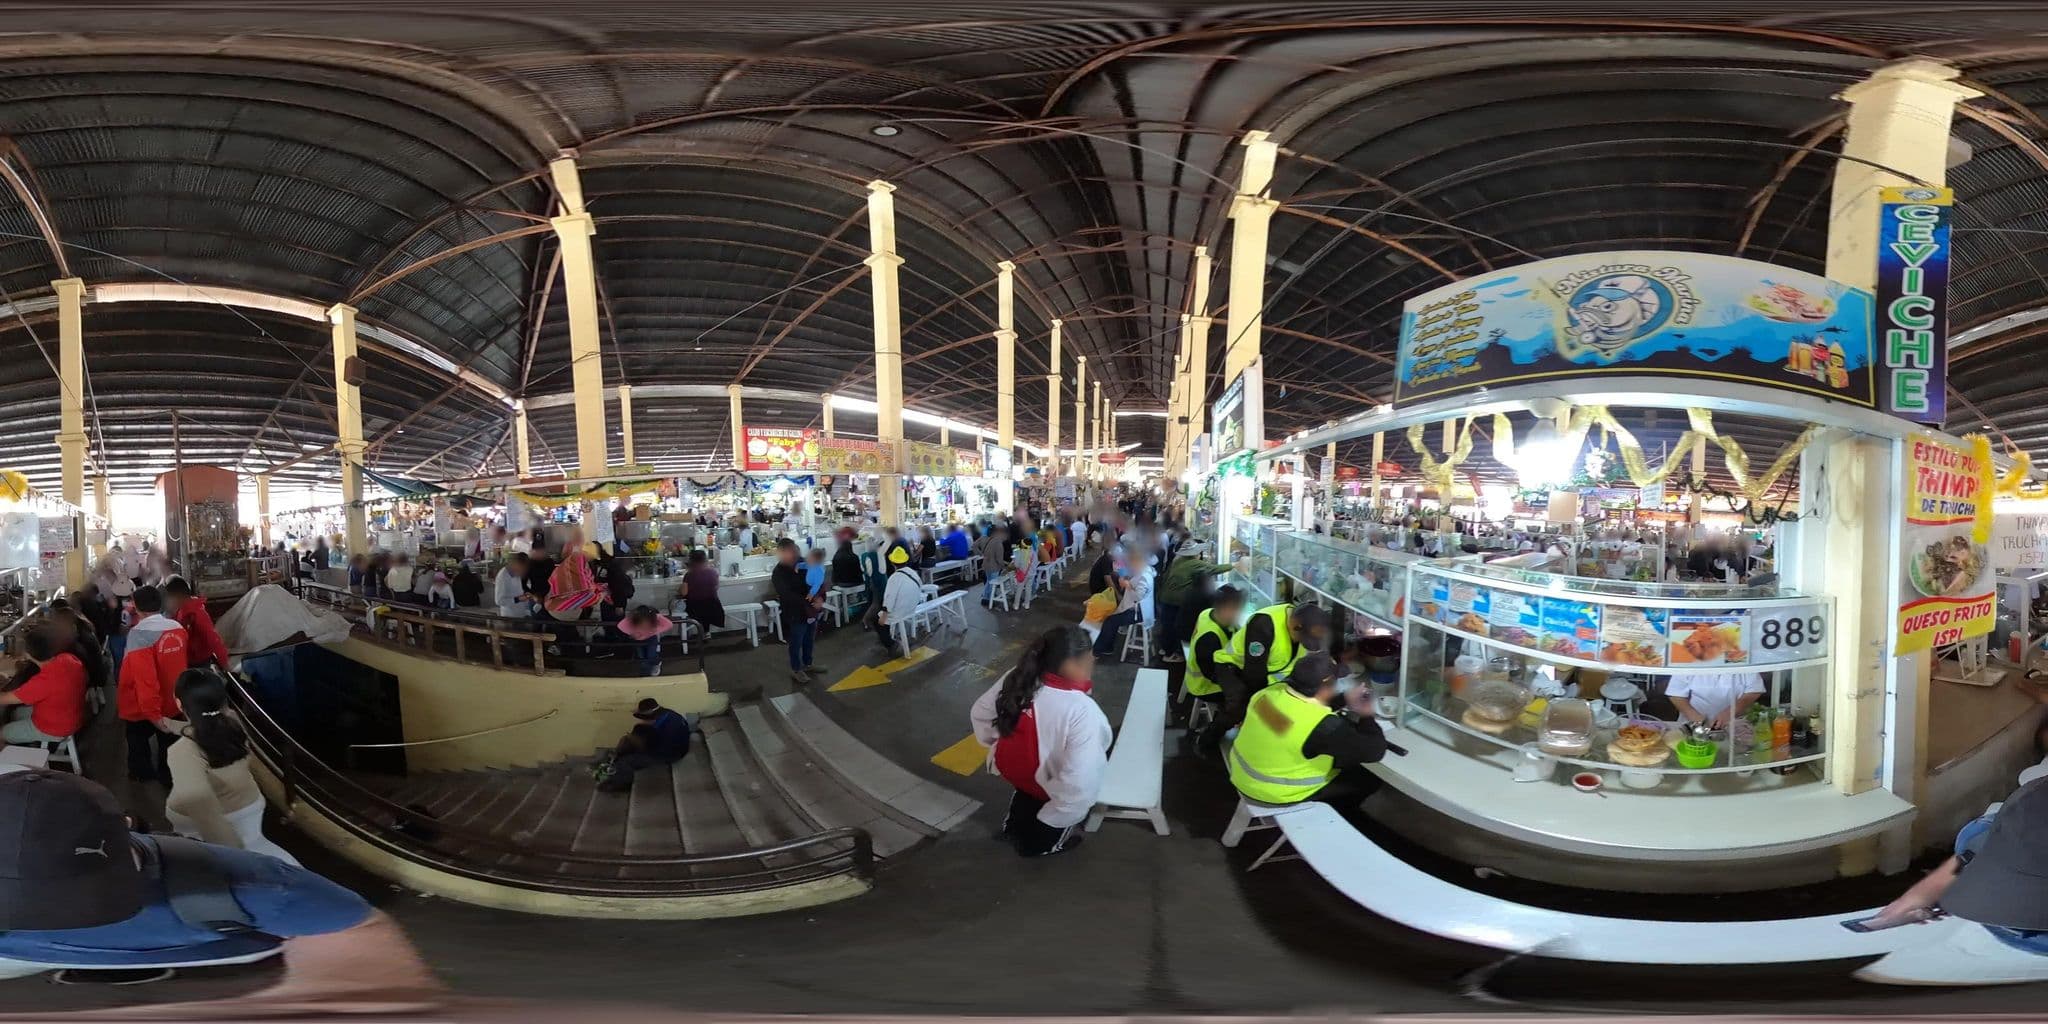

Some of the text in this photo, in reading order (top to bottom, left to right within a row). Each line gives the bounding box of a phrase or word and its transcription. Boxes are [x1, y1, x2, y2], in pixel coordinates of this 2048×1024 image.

[1652, 266, 1701, 325] Marina
[1886, 205, 1939, 413] CEVICHE
[1914, 441, 1957, 468] ESTILO
[1918, 467, 1979, 498] THIMP
[1922, 498, 1975, 515] DE TRUCHA
[1761, 615, 1825, 650] 889
[1903, 602, 1991, 634] QUESO FRITO
[1933, 627, 1963, 646] ISPI
